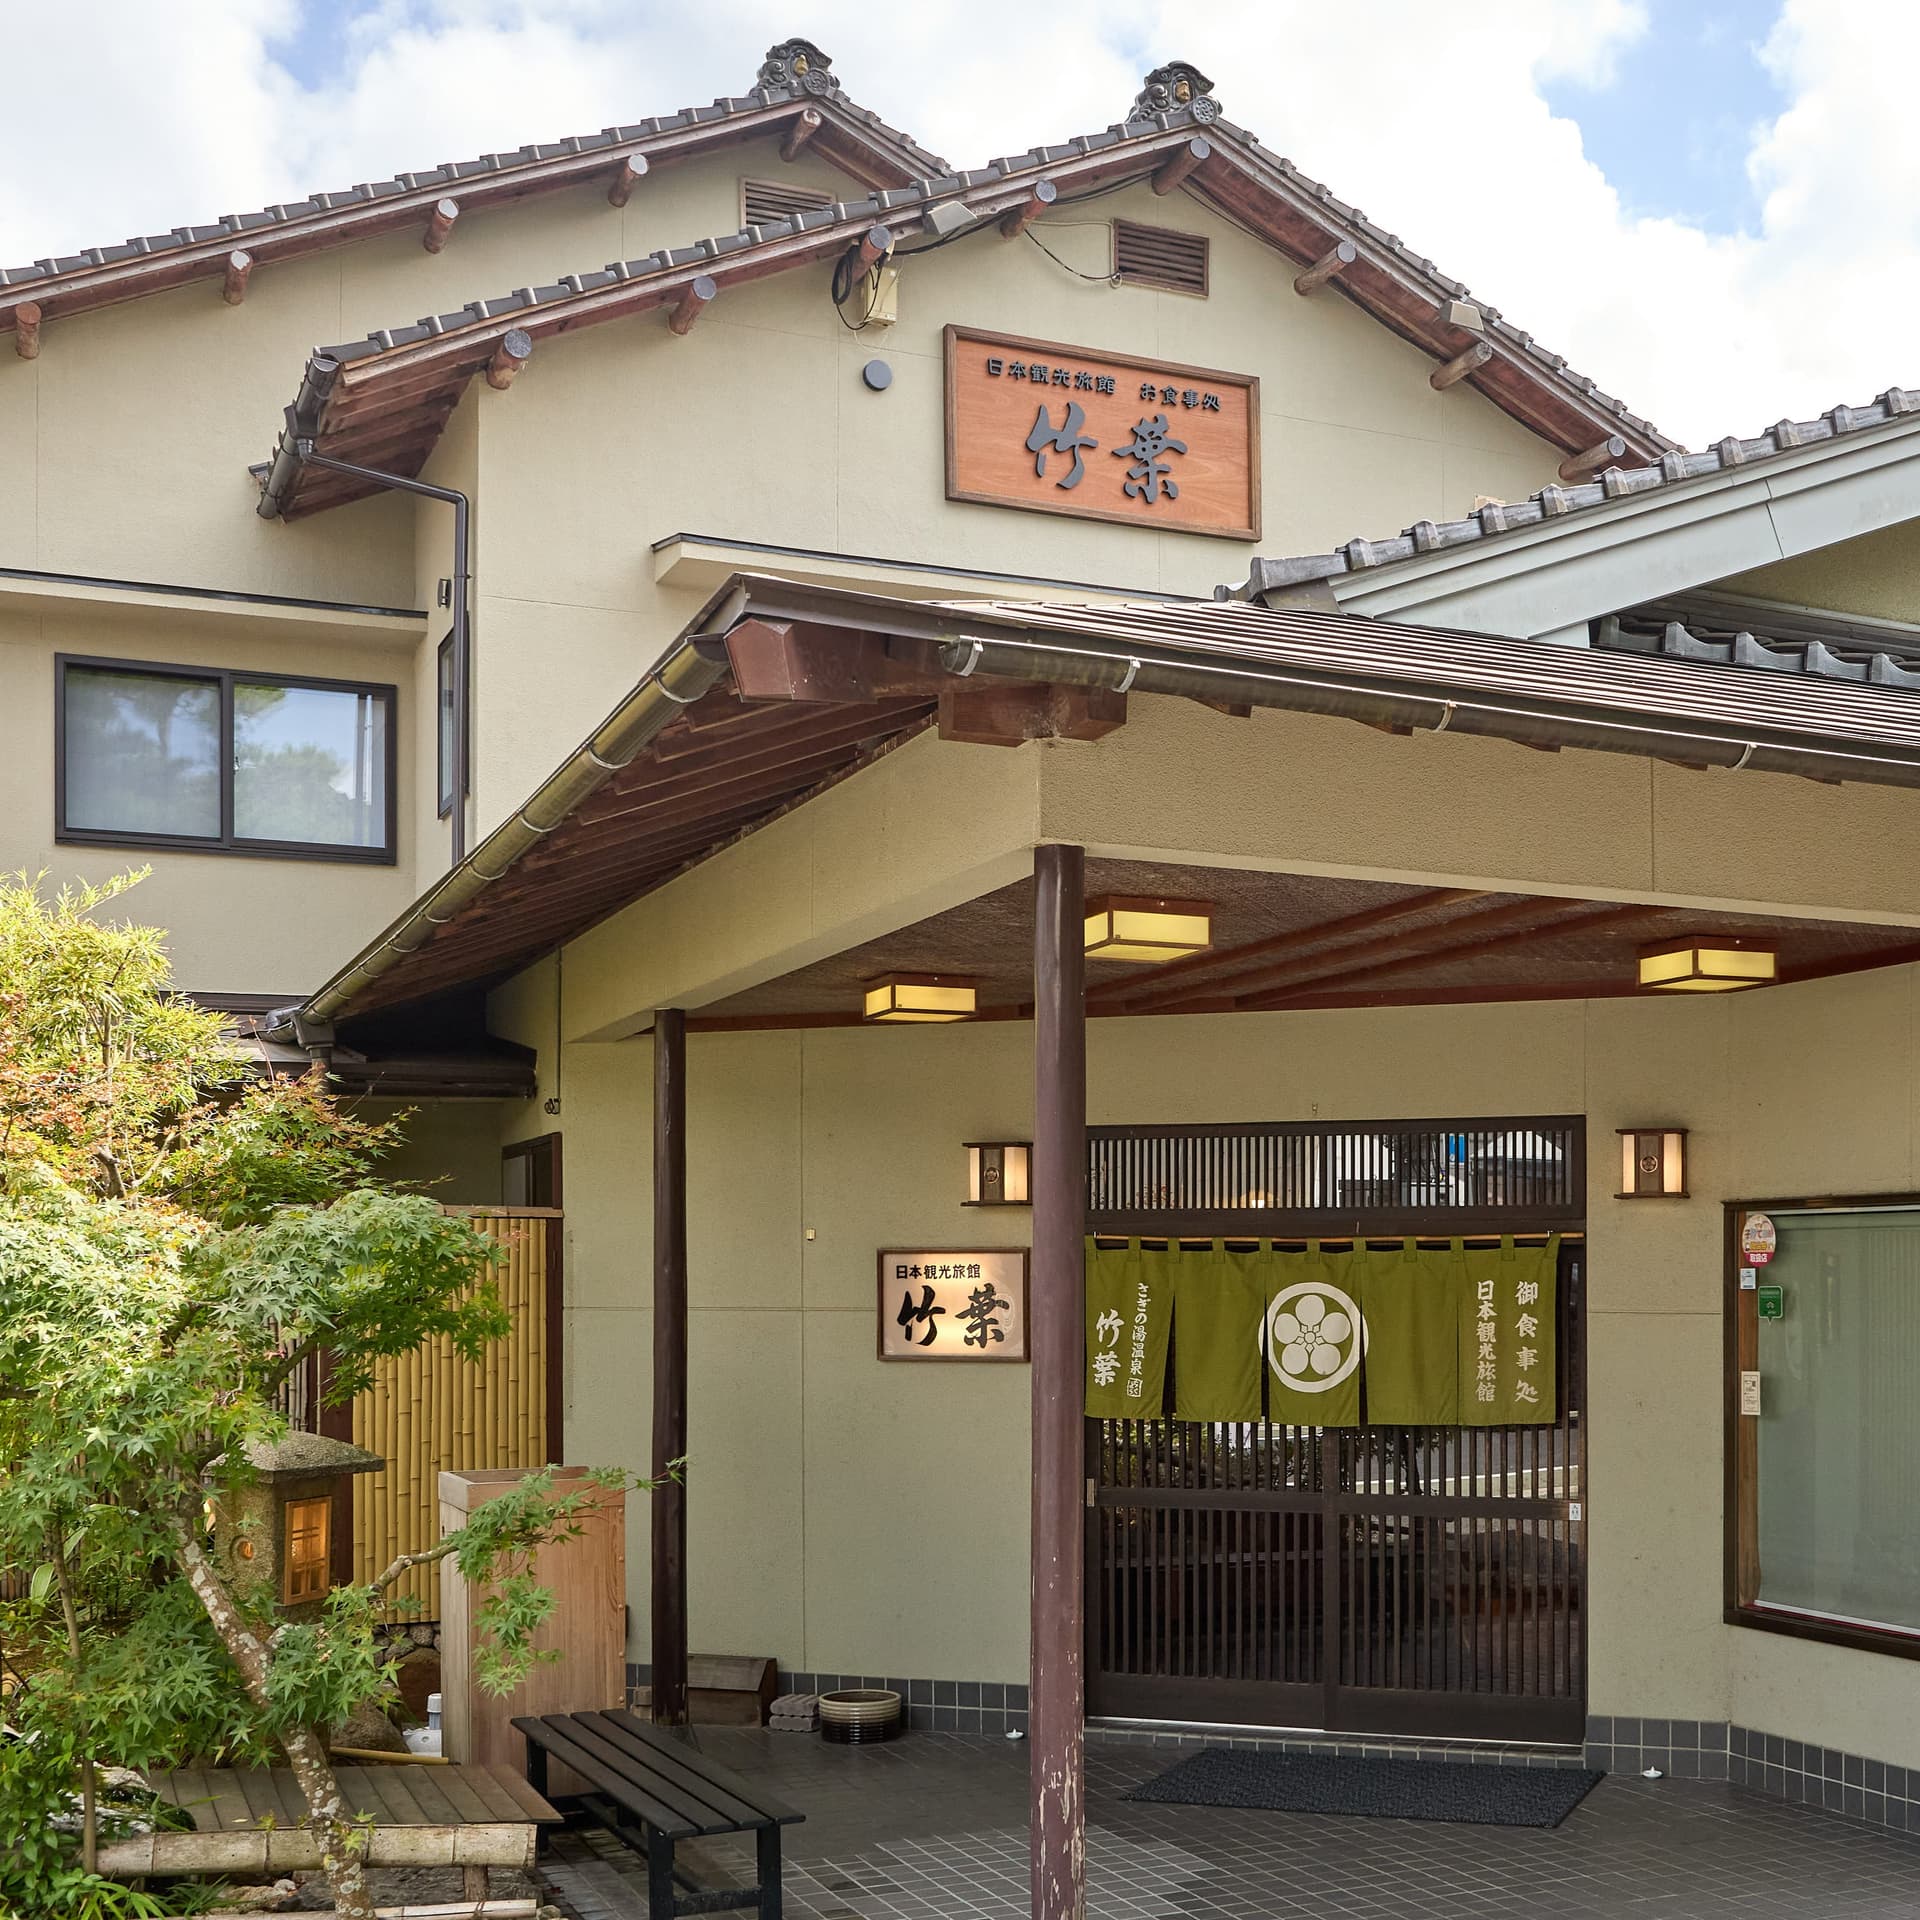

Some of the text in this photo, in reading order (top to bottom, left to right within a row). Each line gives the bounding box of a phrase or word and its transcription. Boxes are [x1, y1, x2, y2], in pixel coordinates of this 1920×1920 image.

[987, 357, 1222, 411] 日本観光旅館 お食事処
[1025, 401, 1188, 505] 竹葉
[895, 1264, 981, 1280] 日本観光旅館
[896, 1283, 1010, 1349] 竹葉
[1091, 1308, 1125, 1387] 竹葉
[1130, 1282, 1152, 1376] さぎの湯温泉
[1475, 1279, 1498, 1402] 日本観光旅館
[1514, 1280, 1540, 1404] 御食事処
